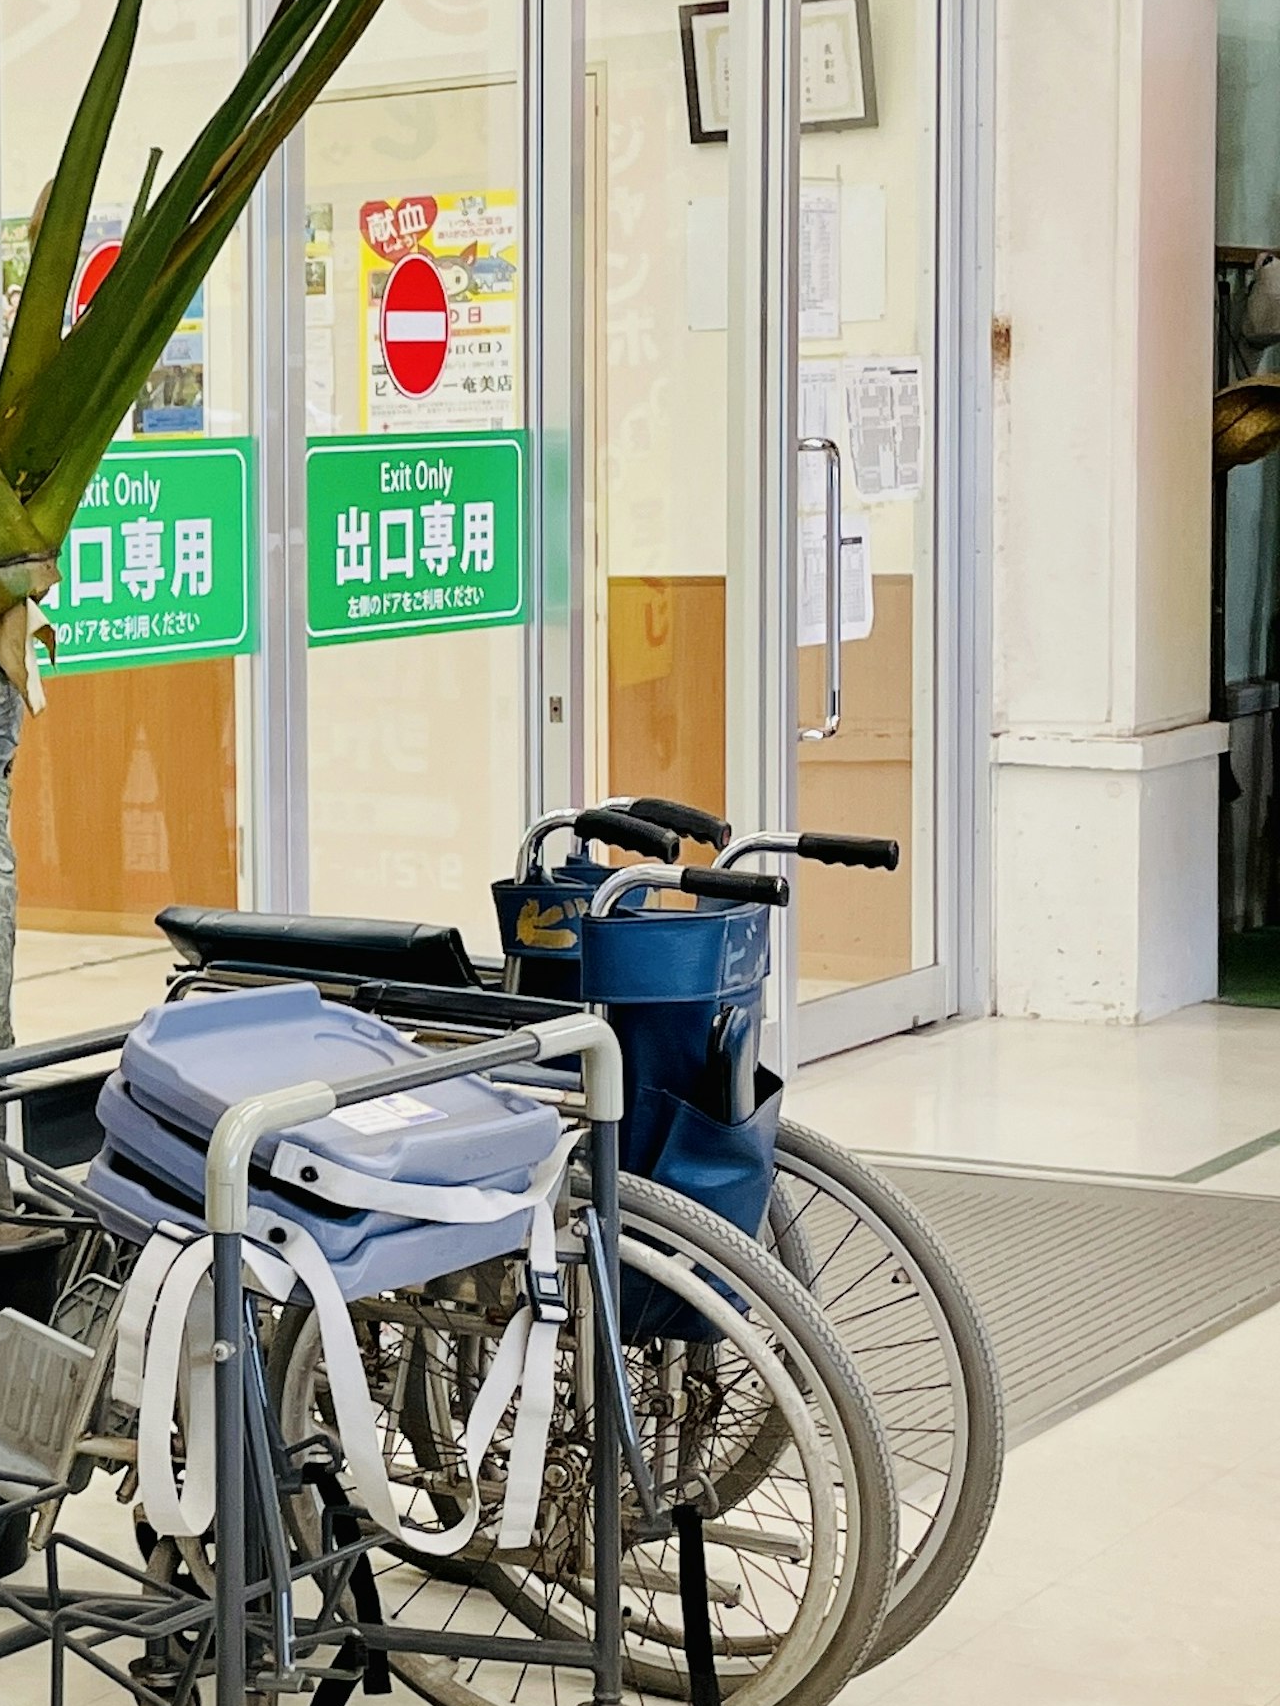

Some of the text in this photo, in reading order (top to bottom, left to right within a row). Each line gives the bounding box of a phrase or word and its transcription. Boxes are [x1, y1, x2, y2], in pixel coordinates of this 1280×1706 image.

[366, 202, 427, 244] 献血
[79, 471, 160, 513] xit Only
[381, 458, 453, 497] Exit Only
[40, 517, 213, 610] 口専用
[336, 500, 495, 586] 出口専用
[348, 586, 485, 619] 左側のドアをご利用ください
[34, 611, 200, 649] のドアをご利用ください
